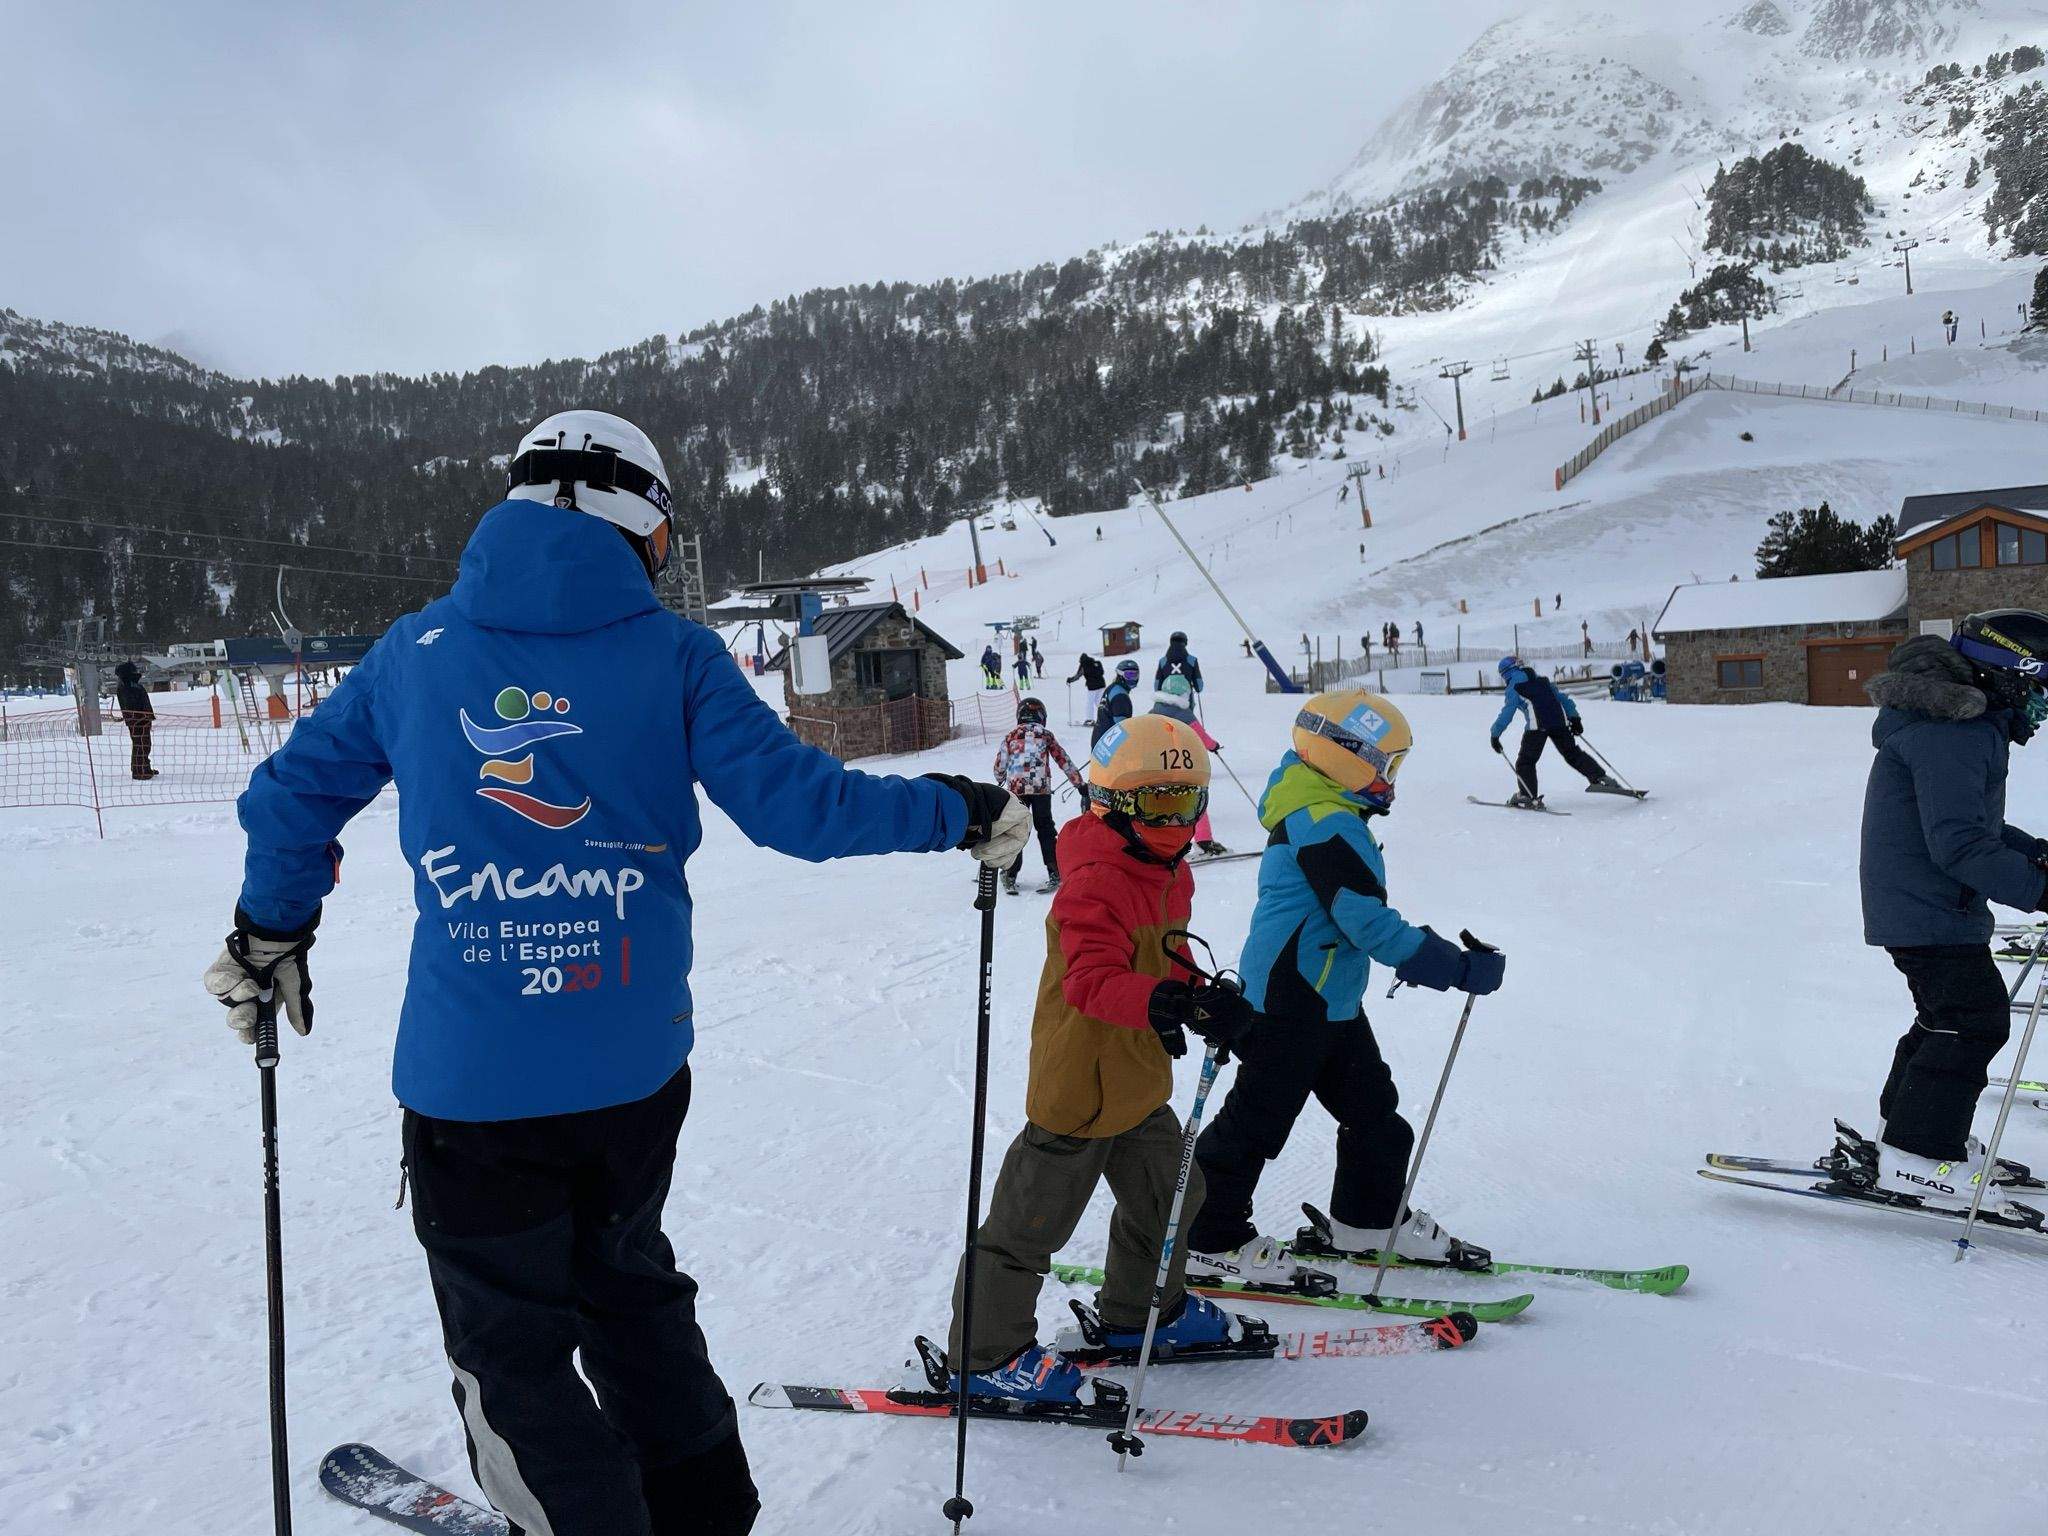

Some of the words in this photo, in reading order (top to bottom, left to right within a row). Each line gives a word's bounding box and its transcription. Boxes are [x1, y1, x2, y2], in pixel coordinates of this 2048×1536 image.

[1159, 748, 1194, 770] 128
[420, 845, 645, 920] Encamp
[448, 922, 490, 939] Vila
[499, 919, 601, 940] Europea
[463, 945, 492, 962] de
[521, 963, 602, 995] 2020
[1896, 1170, 1955, 1195] HEAD
[1187, 1251, 1241, 1275] HEAD
